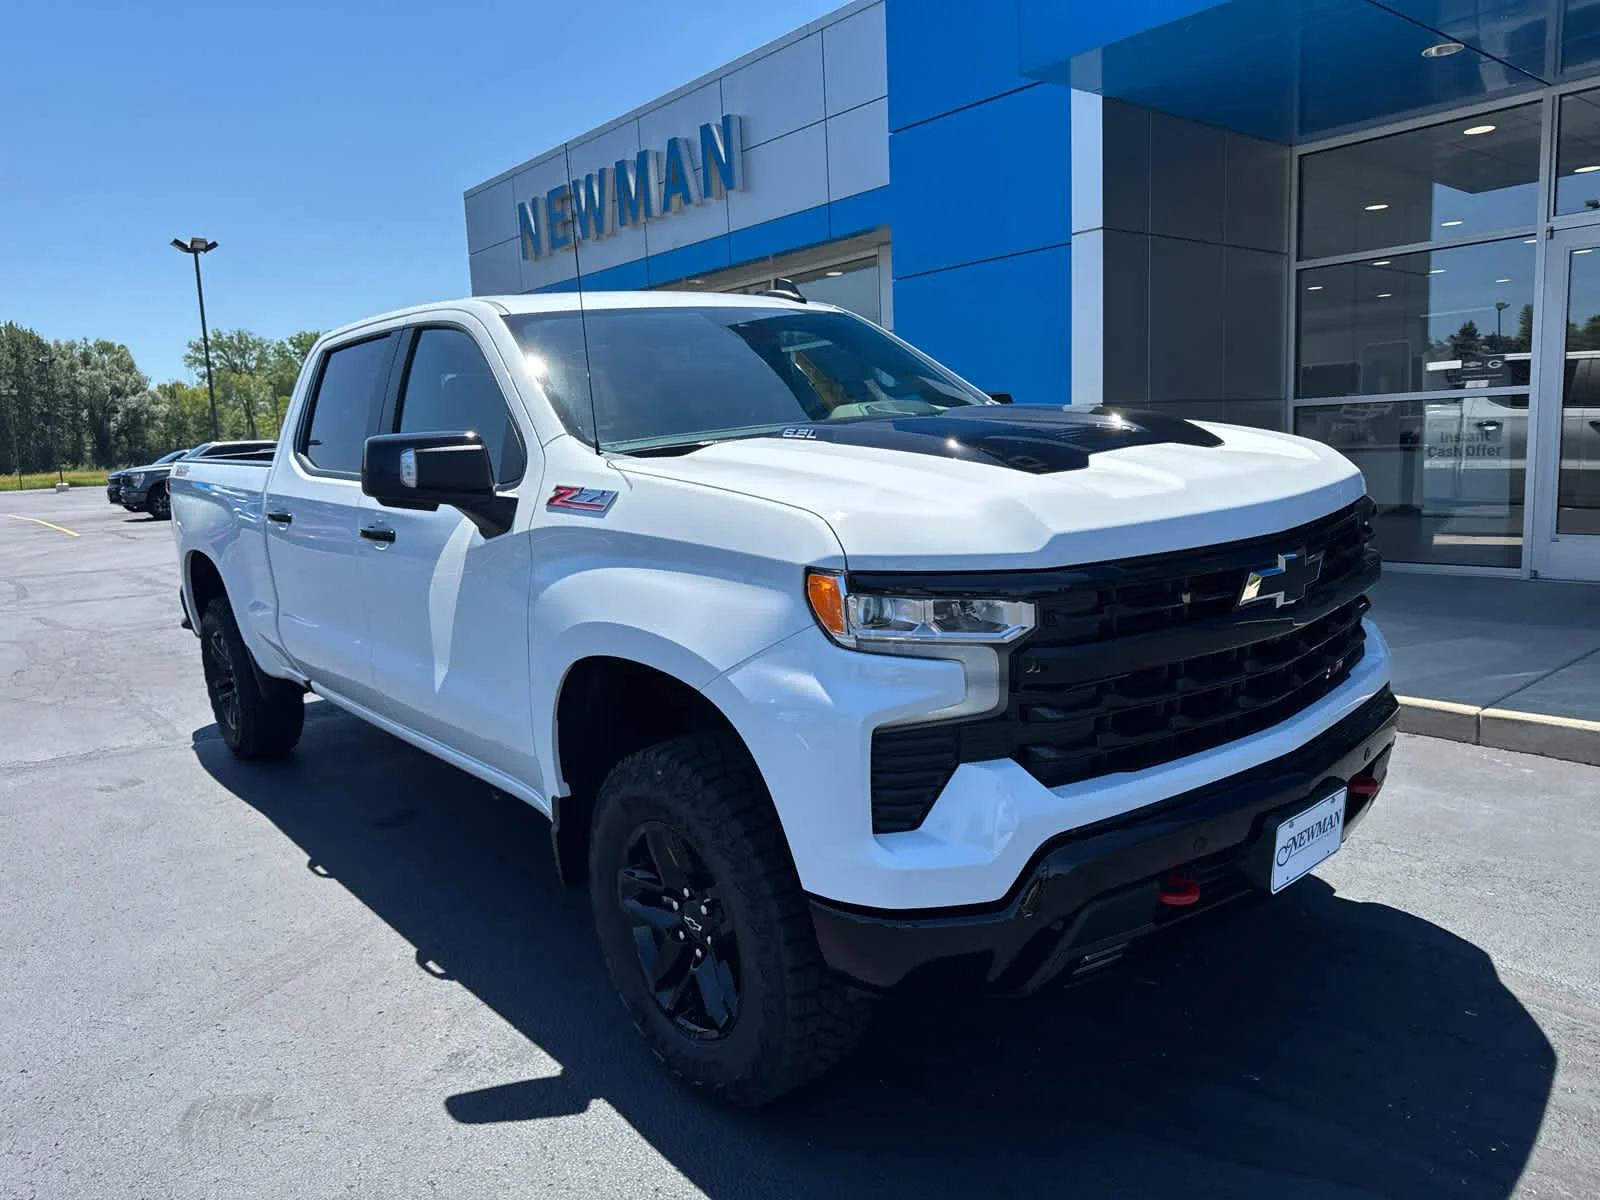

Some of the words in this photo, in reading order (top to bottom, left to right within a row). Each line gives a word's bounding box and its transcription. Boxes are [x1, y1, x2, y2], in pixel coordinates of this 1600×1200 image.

[518, 114, 742, 261] NEWMAN
[1428, 446, 1463, 457] Cash
[1465, 444, 1504, 457] Offer
[1276, 808, 1343, 867] NEWMAN
